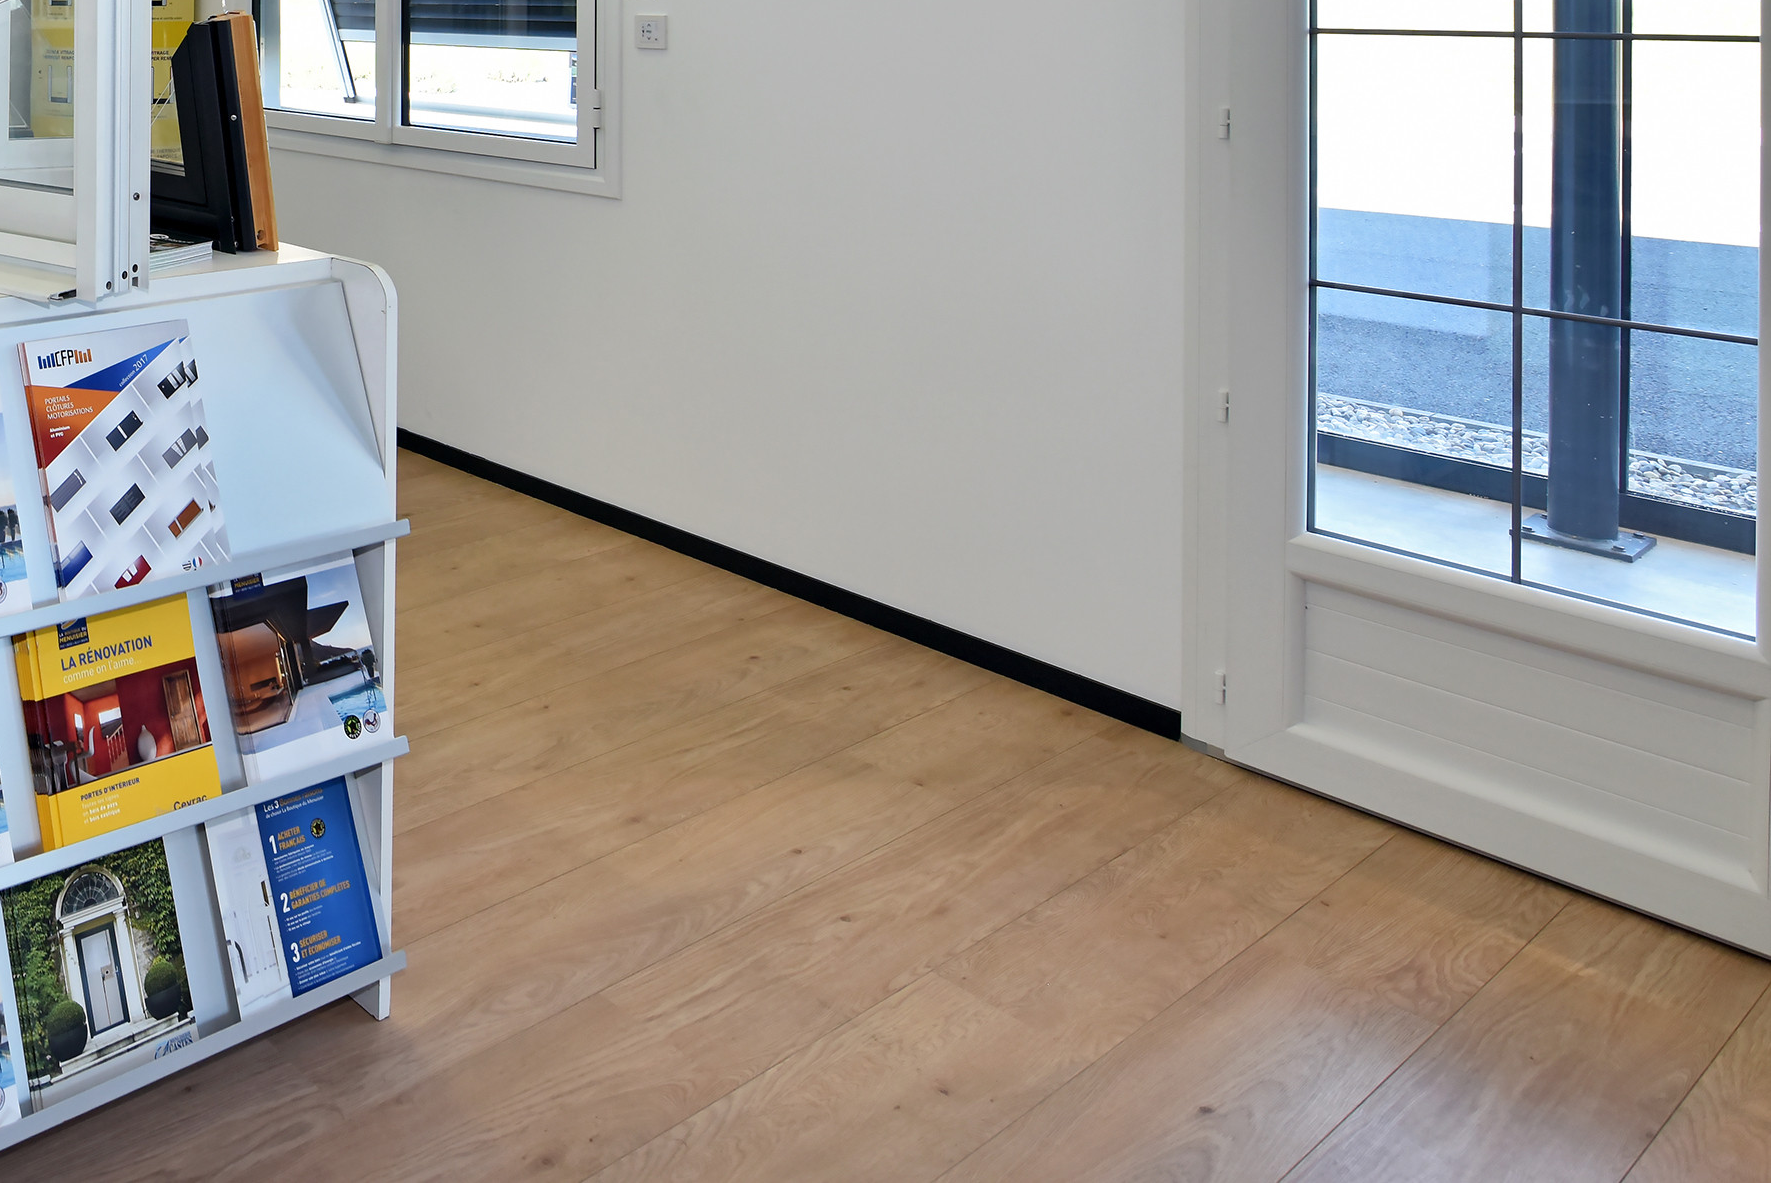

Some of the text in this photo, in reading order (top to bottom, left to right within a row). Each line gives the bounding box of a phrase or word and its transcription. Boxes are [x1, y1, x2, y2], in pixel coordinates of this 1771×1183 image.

[132, 353, 148, 371] 2017
[44, 394, 70, 405] PORTAILS
[46, 402, 74, 413] CLÔTURES
[47, 406, 94, 420] MOTORISATIONS
[61, 656, 77, 671] LA
[78, 635, 153, 666] RÉNOVATION
[63, 667, 94, 684] comme
[96, 664, 107, 674] on
[80, 777, 140, 801] PORTES D'INTÉRIEUR
[263, 803, 274, 813] Les
[274, 800, 279, 809] 3
[277, 826, 301, 841] ACHETER
[279, 834, 306, 850] FRANÇAIS
[269, 835, 277, 854] 1
[280, 892, 291, 913] 2
[291, 892, 321, 909] GARANTIES
[291, 942, 301, 963] 3
[308, 935, 342, 955] ÉCONOMISER
